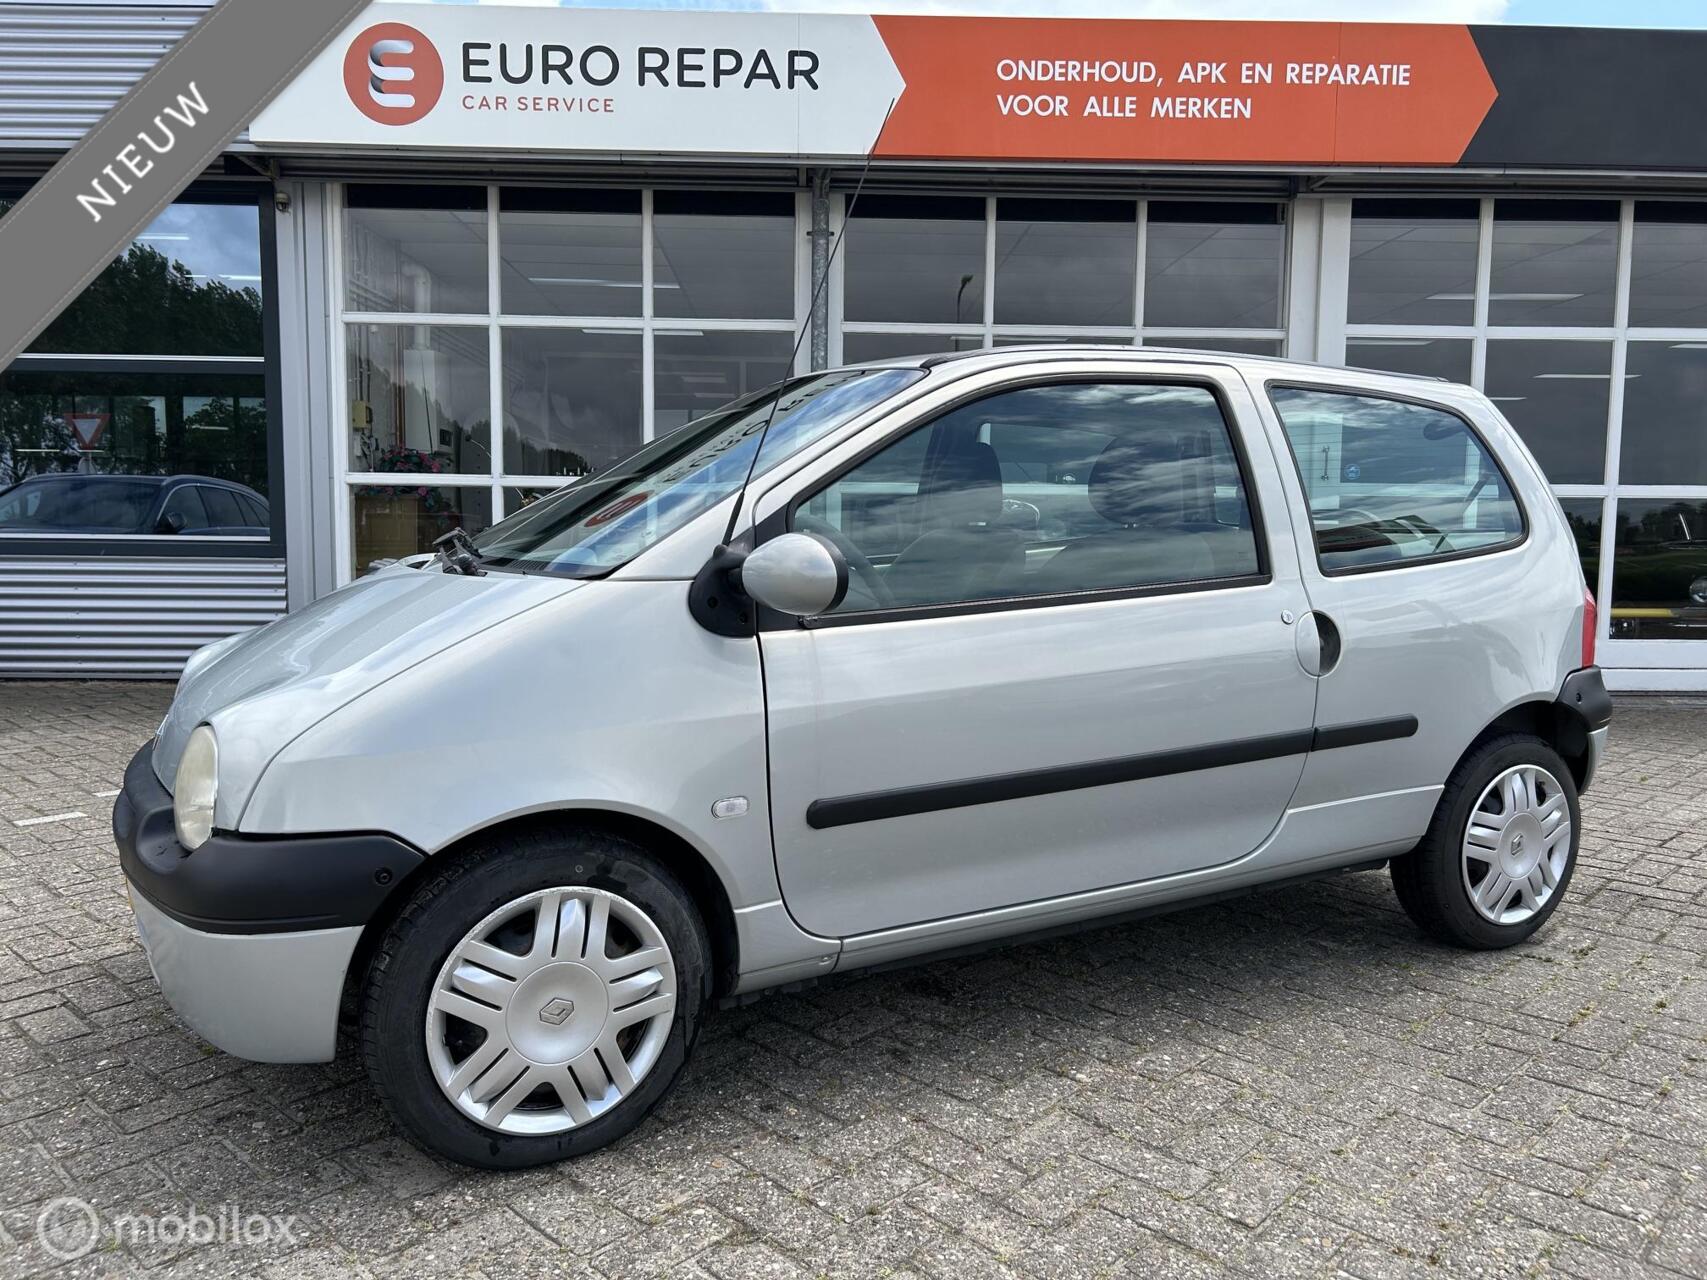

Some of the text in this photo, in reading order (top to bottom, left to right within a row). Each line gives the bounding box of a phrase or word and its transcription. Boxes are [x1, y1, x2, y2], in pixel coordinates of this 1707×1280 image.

[462, 42, 820, 91] EURO REPAR
[996, 59, 1411, 87] ONDERHOUD, APK EN REPARATIE
[462, 95, 615, 113] CAR SERVICE
[996, 94, 1252, 119] VOOR ALLE MERKEN
